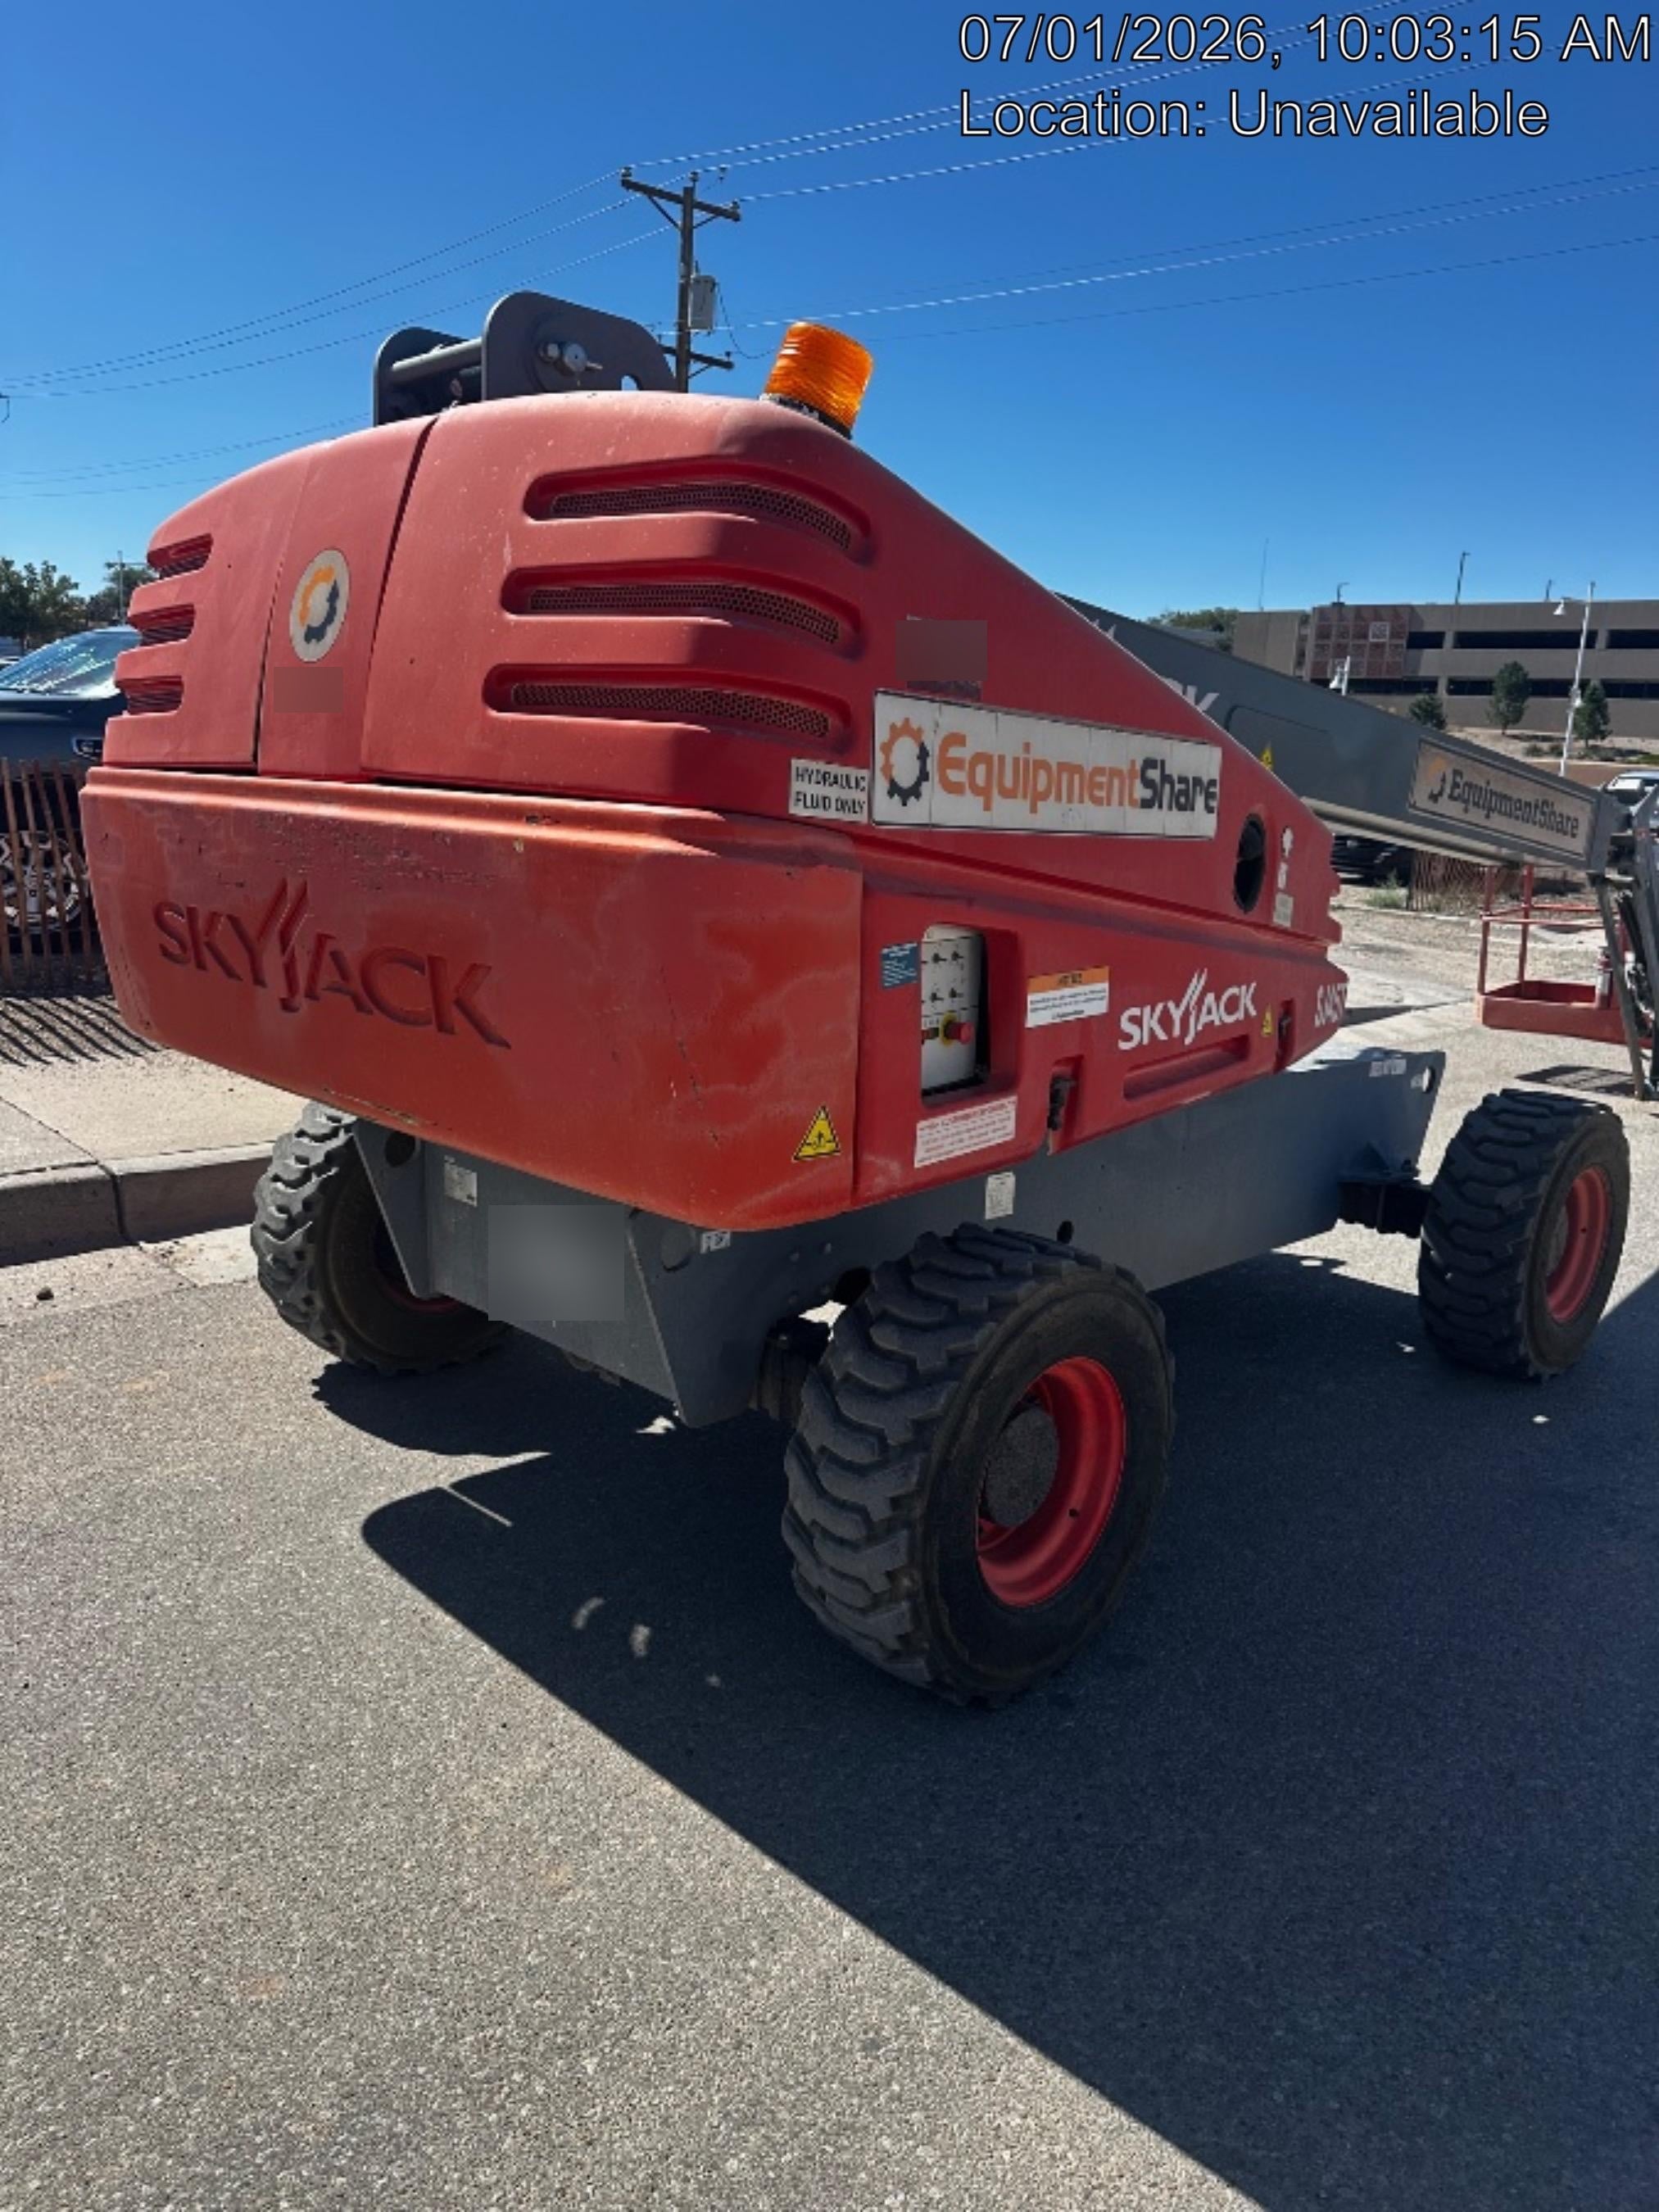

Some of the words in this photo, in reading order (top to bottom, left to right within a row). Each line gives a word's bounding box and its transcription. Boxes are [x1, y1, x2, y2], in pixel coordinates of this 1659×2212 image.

[794, 791, 832, 812] FLUID
[835, 796, 866, 814] ONLY
[795, 766, 867, 792] HYDRAULIC
[938, 732, 1218, 814] EquipmentShare
[1447, 768, 1580, 839] EquipmentShare
[153, 877, 512, 1050] SKYJACK
[1117, 968, 1258, 1050] SKYJACK
